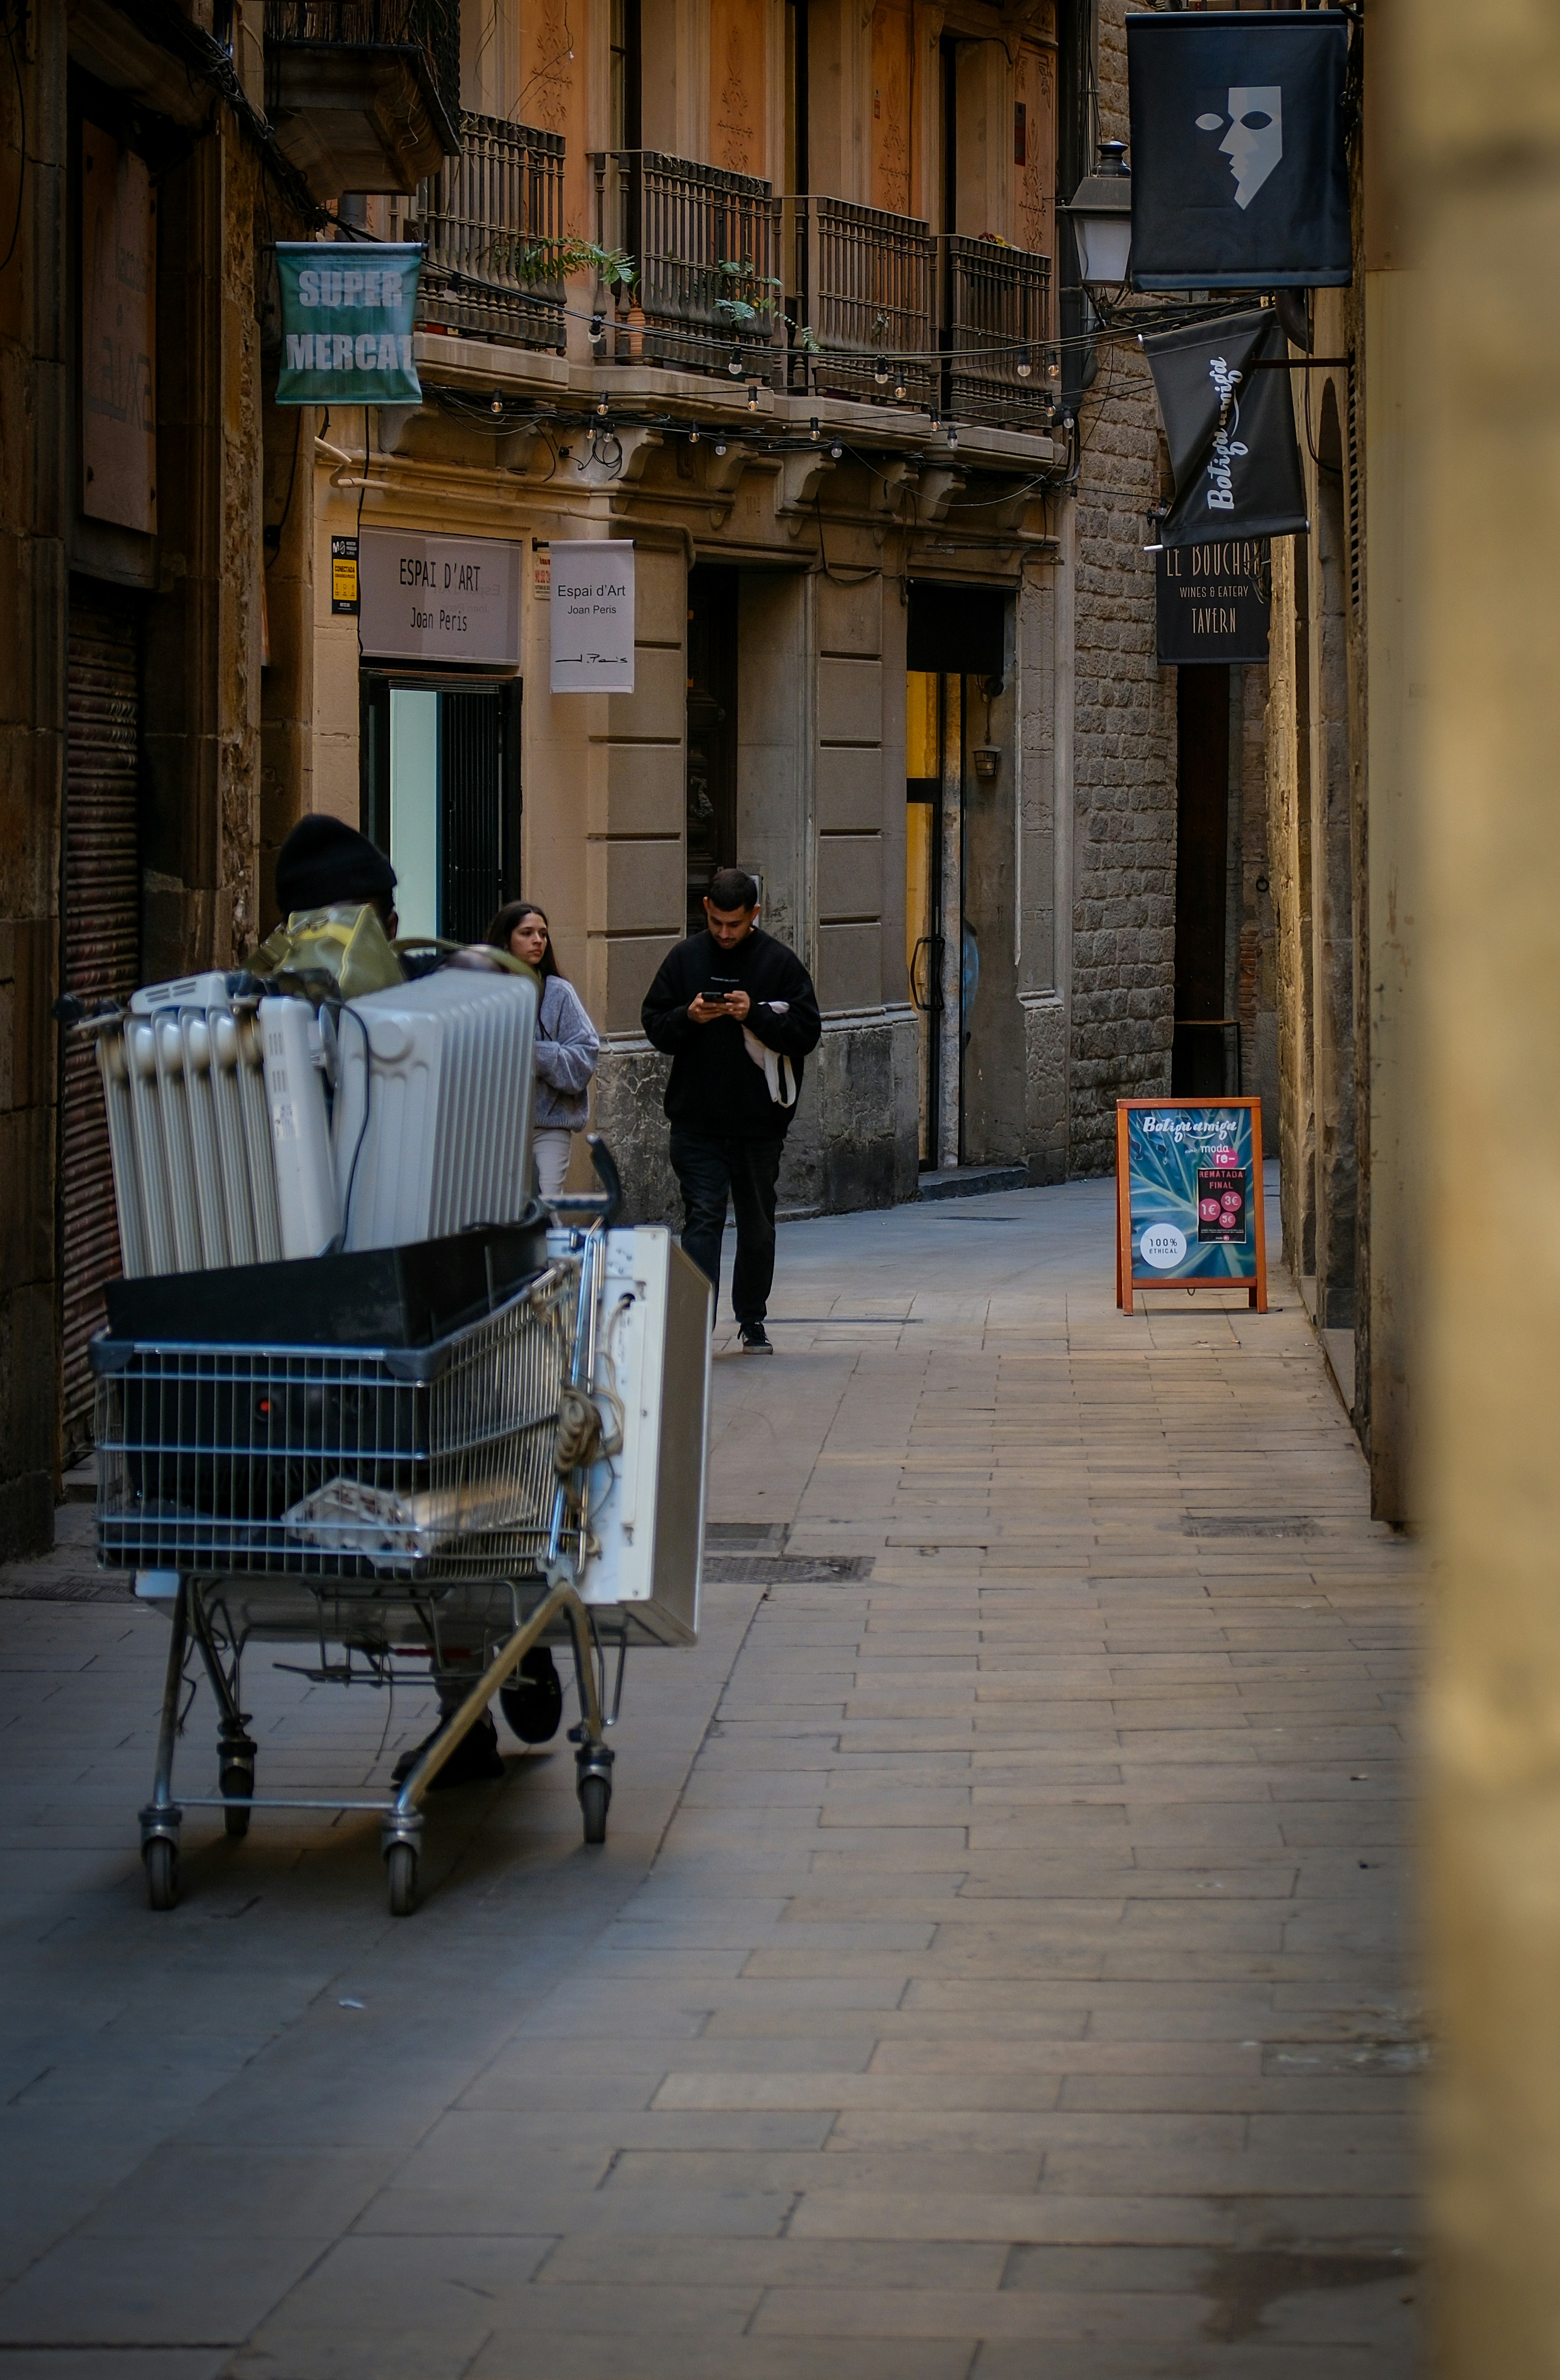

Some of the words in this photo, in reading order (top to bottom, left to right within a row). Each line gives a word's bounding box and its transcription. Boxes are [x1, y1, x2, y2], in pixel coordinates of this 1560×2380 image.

[299, 271, 402, 307] SUPER
[286, 334, 412, 370] MERCAT
[1210, 357, 1243, 425] amiga
[1207, 428, 1248, 509] Botiga
[399, 558, 436, 588] ESPAI
[444, 563, 481, 591] D'ART
[1166, 548, 1182, 577] LE
[558, 585, 592, 599] Espai
[596, 585, 626, 596] d'Art
[1180, 586, 1207, 597] WINES
[1210, 586, 1215, 597] &
[1218, 586, 1249, 597] EATERY
[410, 607, 433, 629] Joan
[440, 610, 467, 631] Peris
[567, 605, 590, 614] Joan
[593, 605, 617, 614] Peris
[1192, 608, 1236, 633] TAVERN
[1143, 1117, 1192, 1143] Botiga
[1193, 1121, 1237, 1140] amiga
[1201, 1144, 1229, 1153] moda
[1201, 1204, 1216, 1215] 1€
[1225, 1196, 1238, 1206] 3€
[1222, 1215, 1233, 1223] 5€
[1150, 1239, 1177, 1247] 100%
